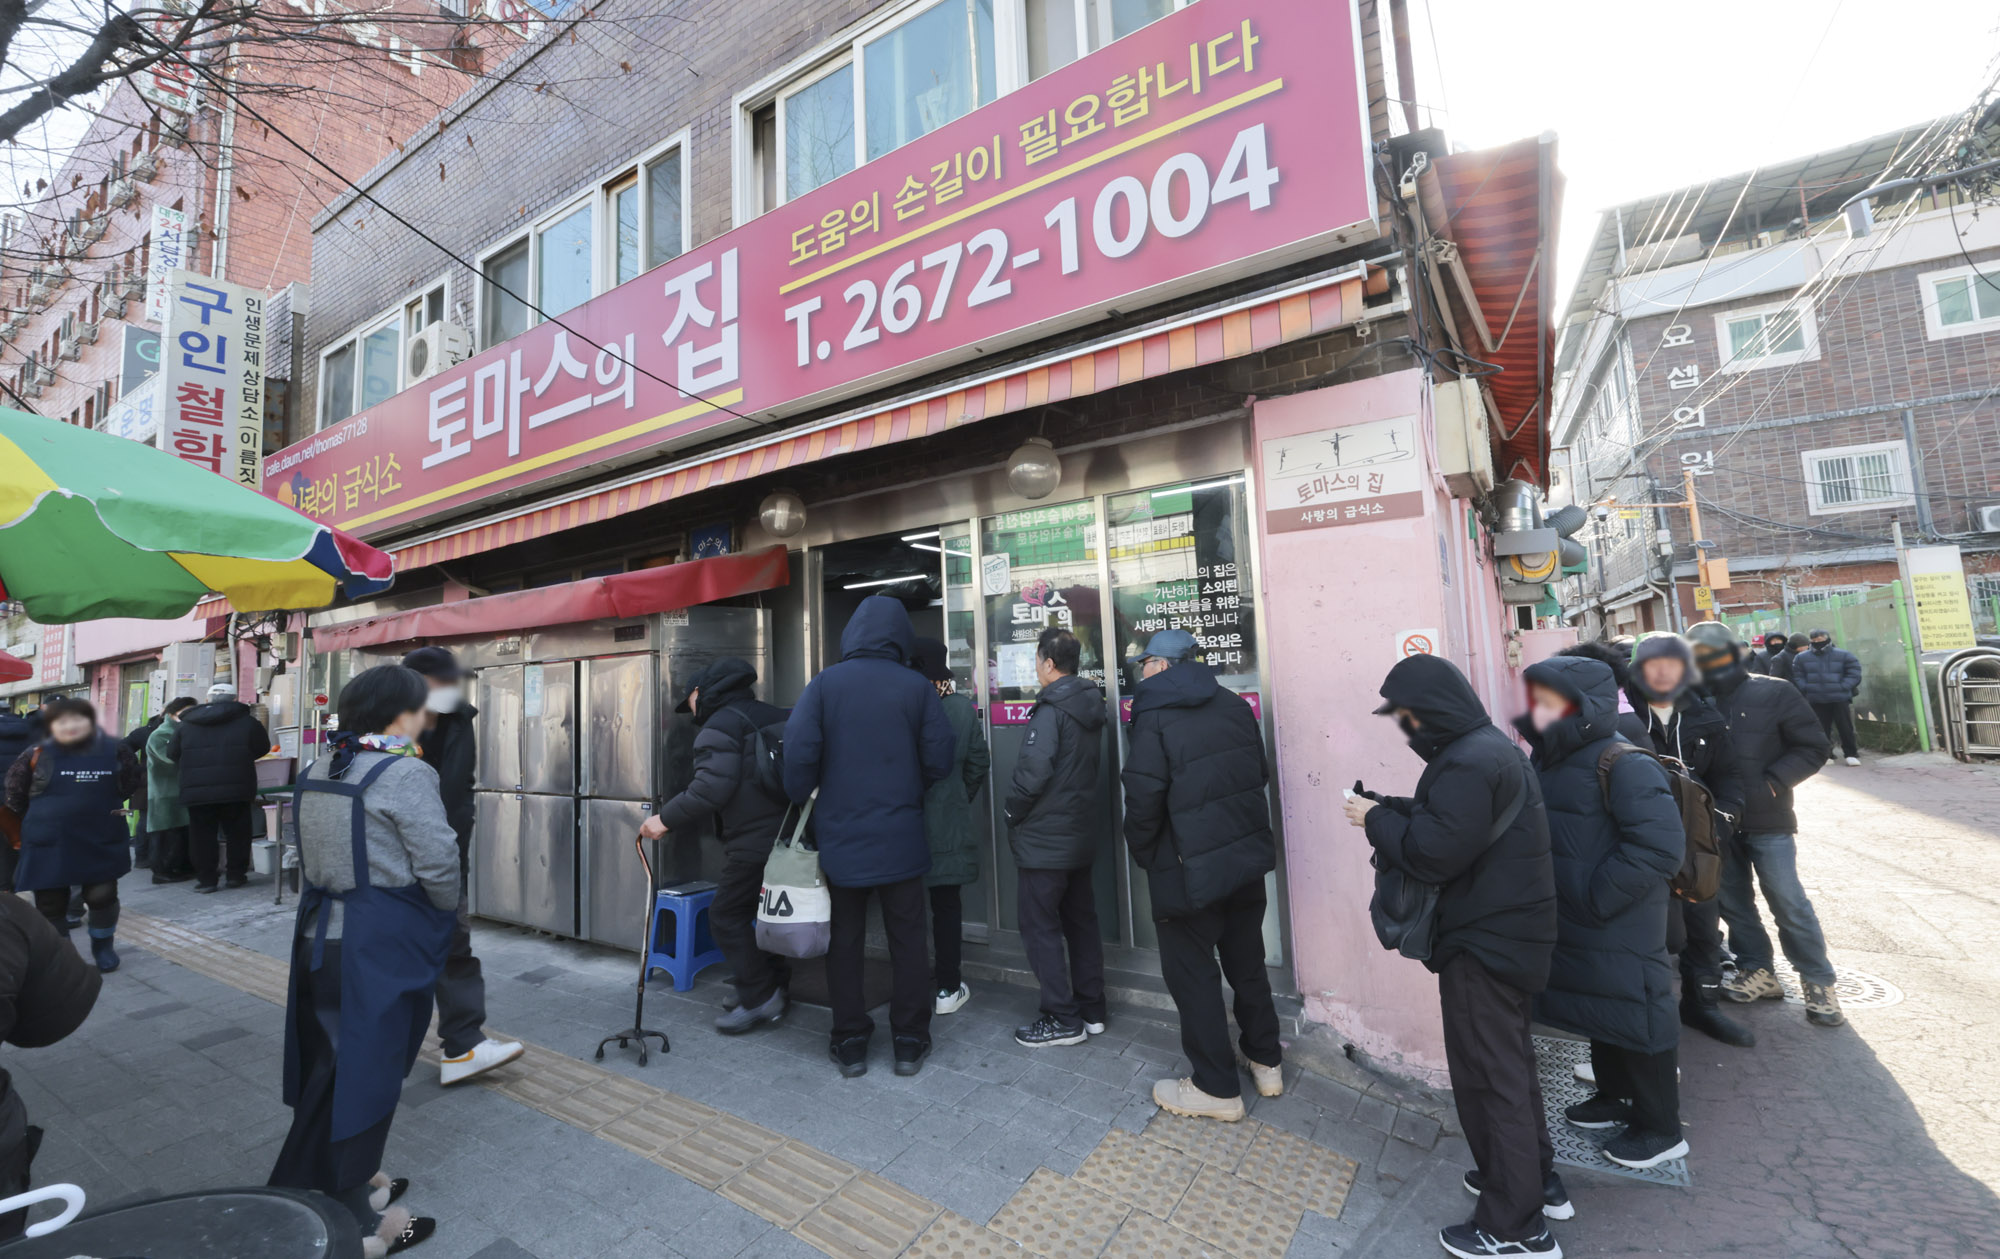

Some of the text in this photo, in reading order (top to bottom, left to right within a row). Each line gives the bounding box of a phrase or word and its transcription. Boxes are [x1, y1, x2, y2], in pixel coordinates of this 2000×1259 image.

[788, 17, 1260, 267] 도움의 손길이 필요합니다
[421, 247, 740, 471] 토마스의 집
[342, 451, 403, 512] 급식소
[1297, 472, 1385, 504] 토마스의 집
[1301, 502, 1386, 523] 사랑의 급식소
[1213, 562, 1237, 578] 집은
[1155, 579, 1238, 599] 가난하고 소외된
[1145, 595, 1240, 615] 어려운분들을 위한
[1134, 612, 1239, 633] 사랑의 급식소입니다
[1205, 651, 1242, 667] 쉽니다
